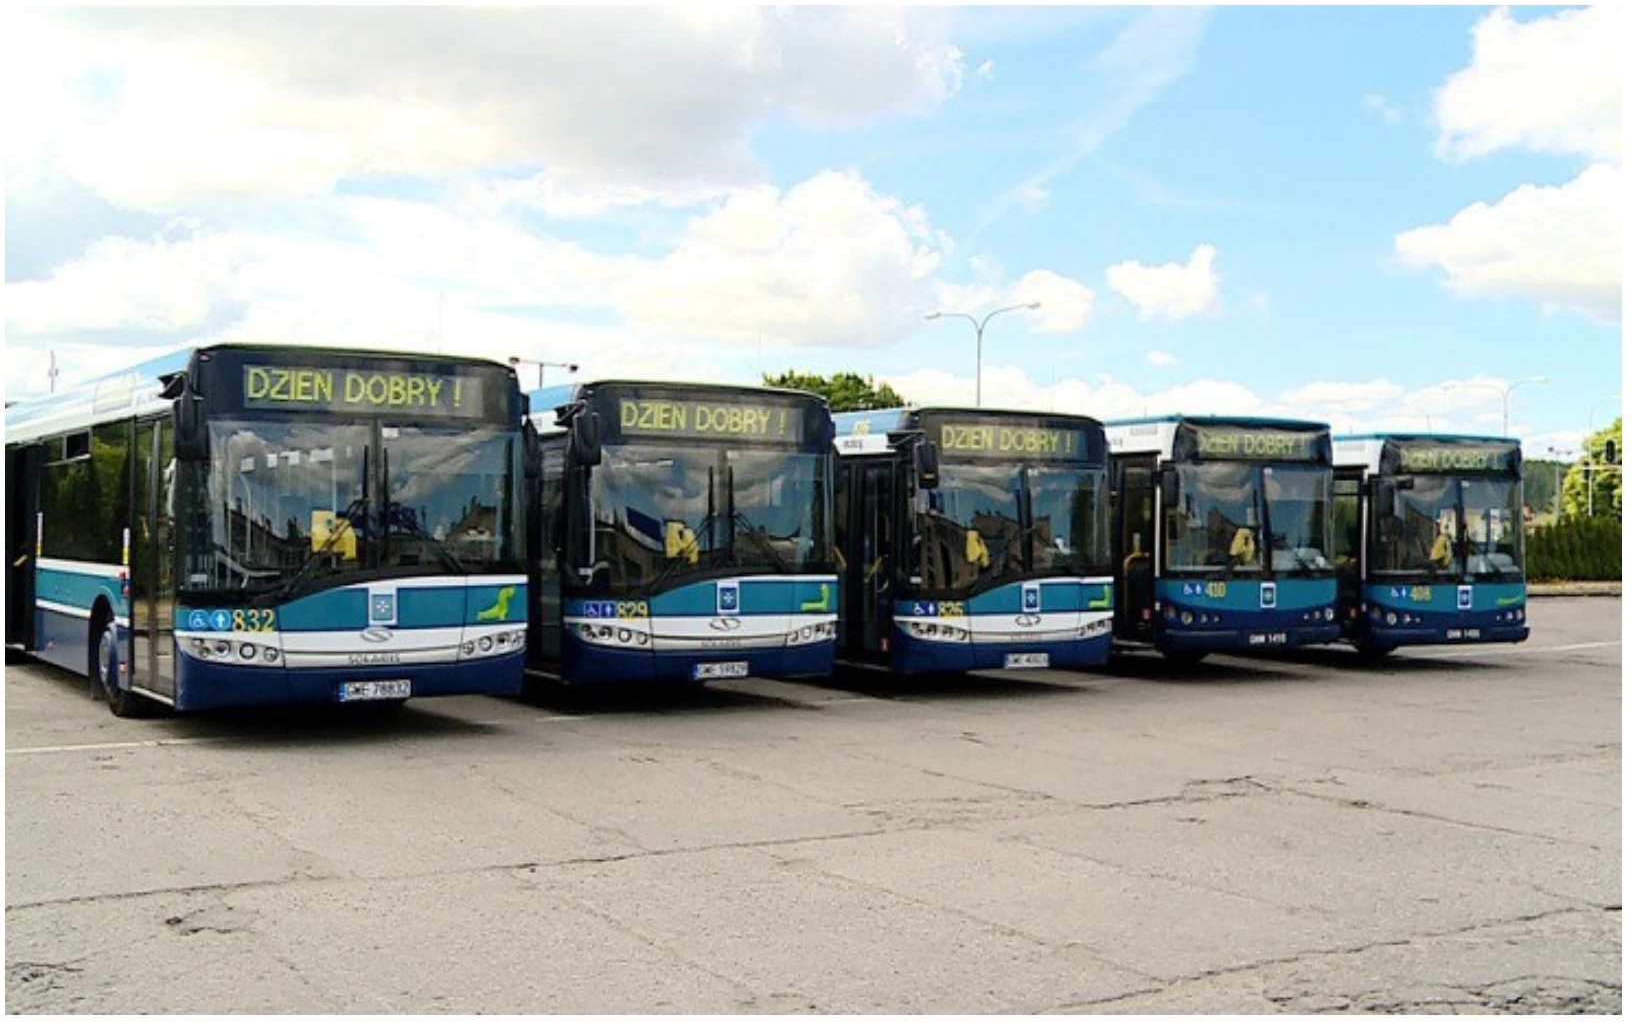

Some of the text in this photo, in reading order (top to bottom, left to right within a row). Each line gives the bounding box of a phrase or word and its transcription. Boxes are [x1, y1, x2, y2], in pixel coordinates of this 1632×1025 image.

[247, 367, 333, 402] DZIEN
[344, 373, 443, 407] DOBRY
[621, 400, 687, 430] DZIEN
[694, 405, 773, 435] DOBRY
[942, 424, 993, 450] DZIEN
[998, 426, 1062, 453] DOBRY
[1244, 432, 1294, 455] DOBRY
[232, 608, 276, 632] 832
[617, 601, 648, 621] 829
